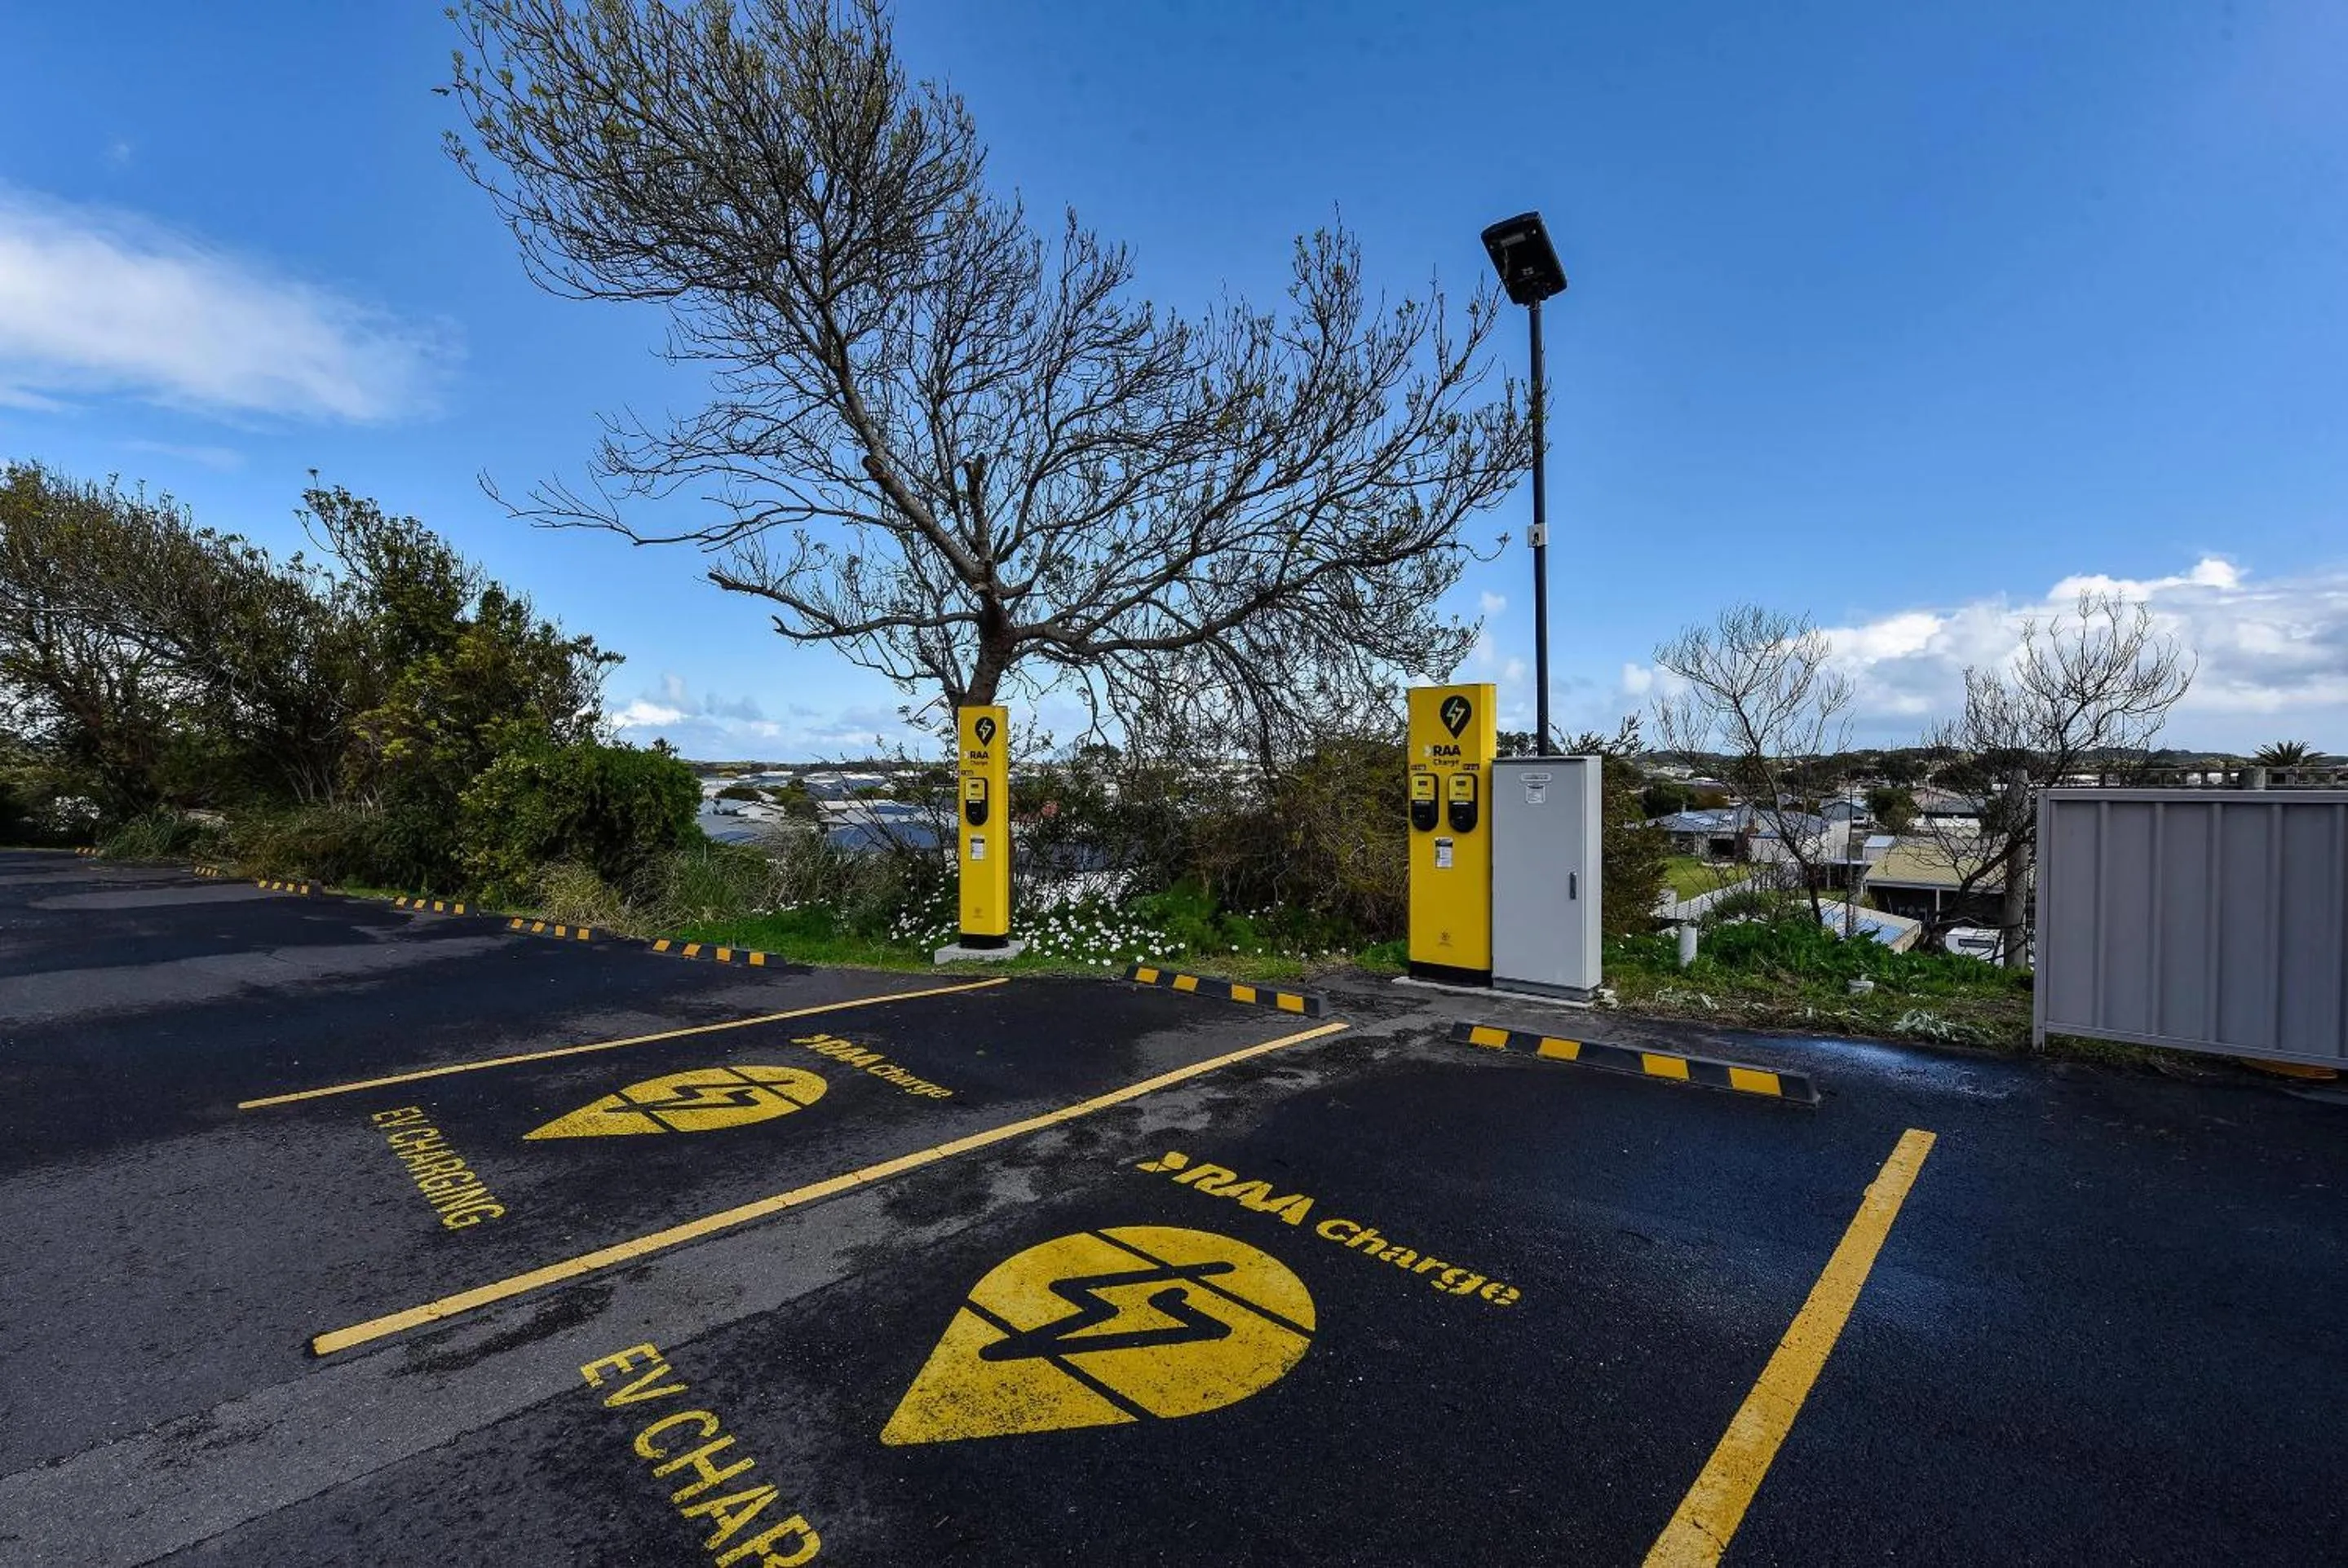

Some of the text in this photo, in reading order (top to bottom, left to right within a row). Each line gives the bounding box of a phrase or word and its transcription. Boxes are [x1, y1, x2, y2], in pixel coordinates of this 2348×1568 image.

[971, 750, 988, 759] RAA
[1433, 744, 1461, 757] RAA
[806, 1039, 953, 1098] RAA Charge
[372, 1106, 505, 1230] EV CHARGING
[1172, 1163, 1522, 1305] RAA Charge
[580, 1342, 821, 1568] EV CHAR
